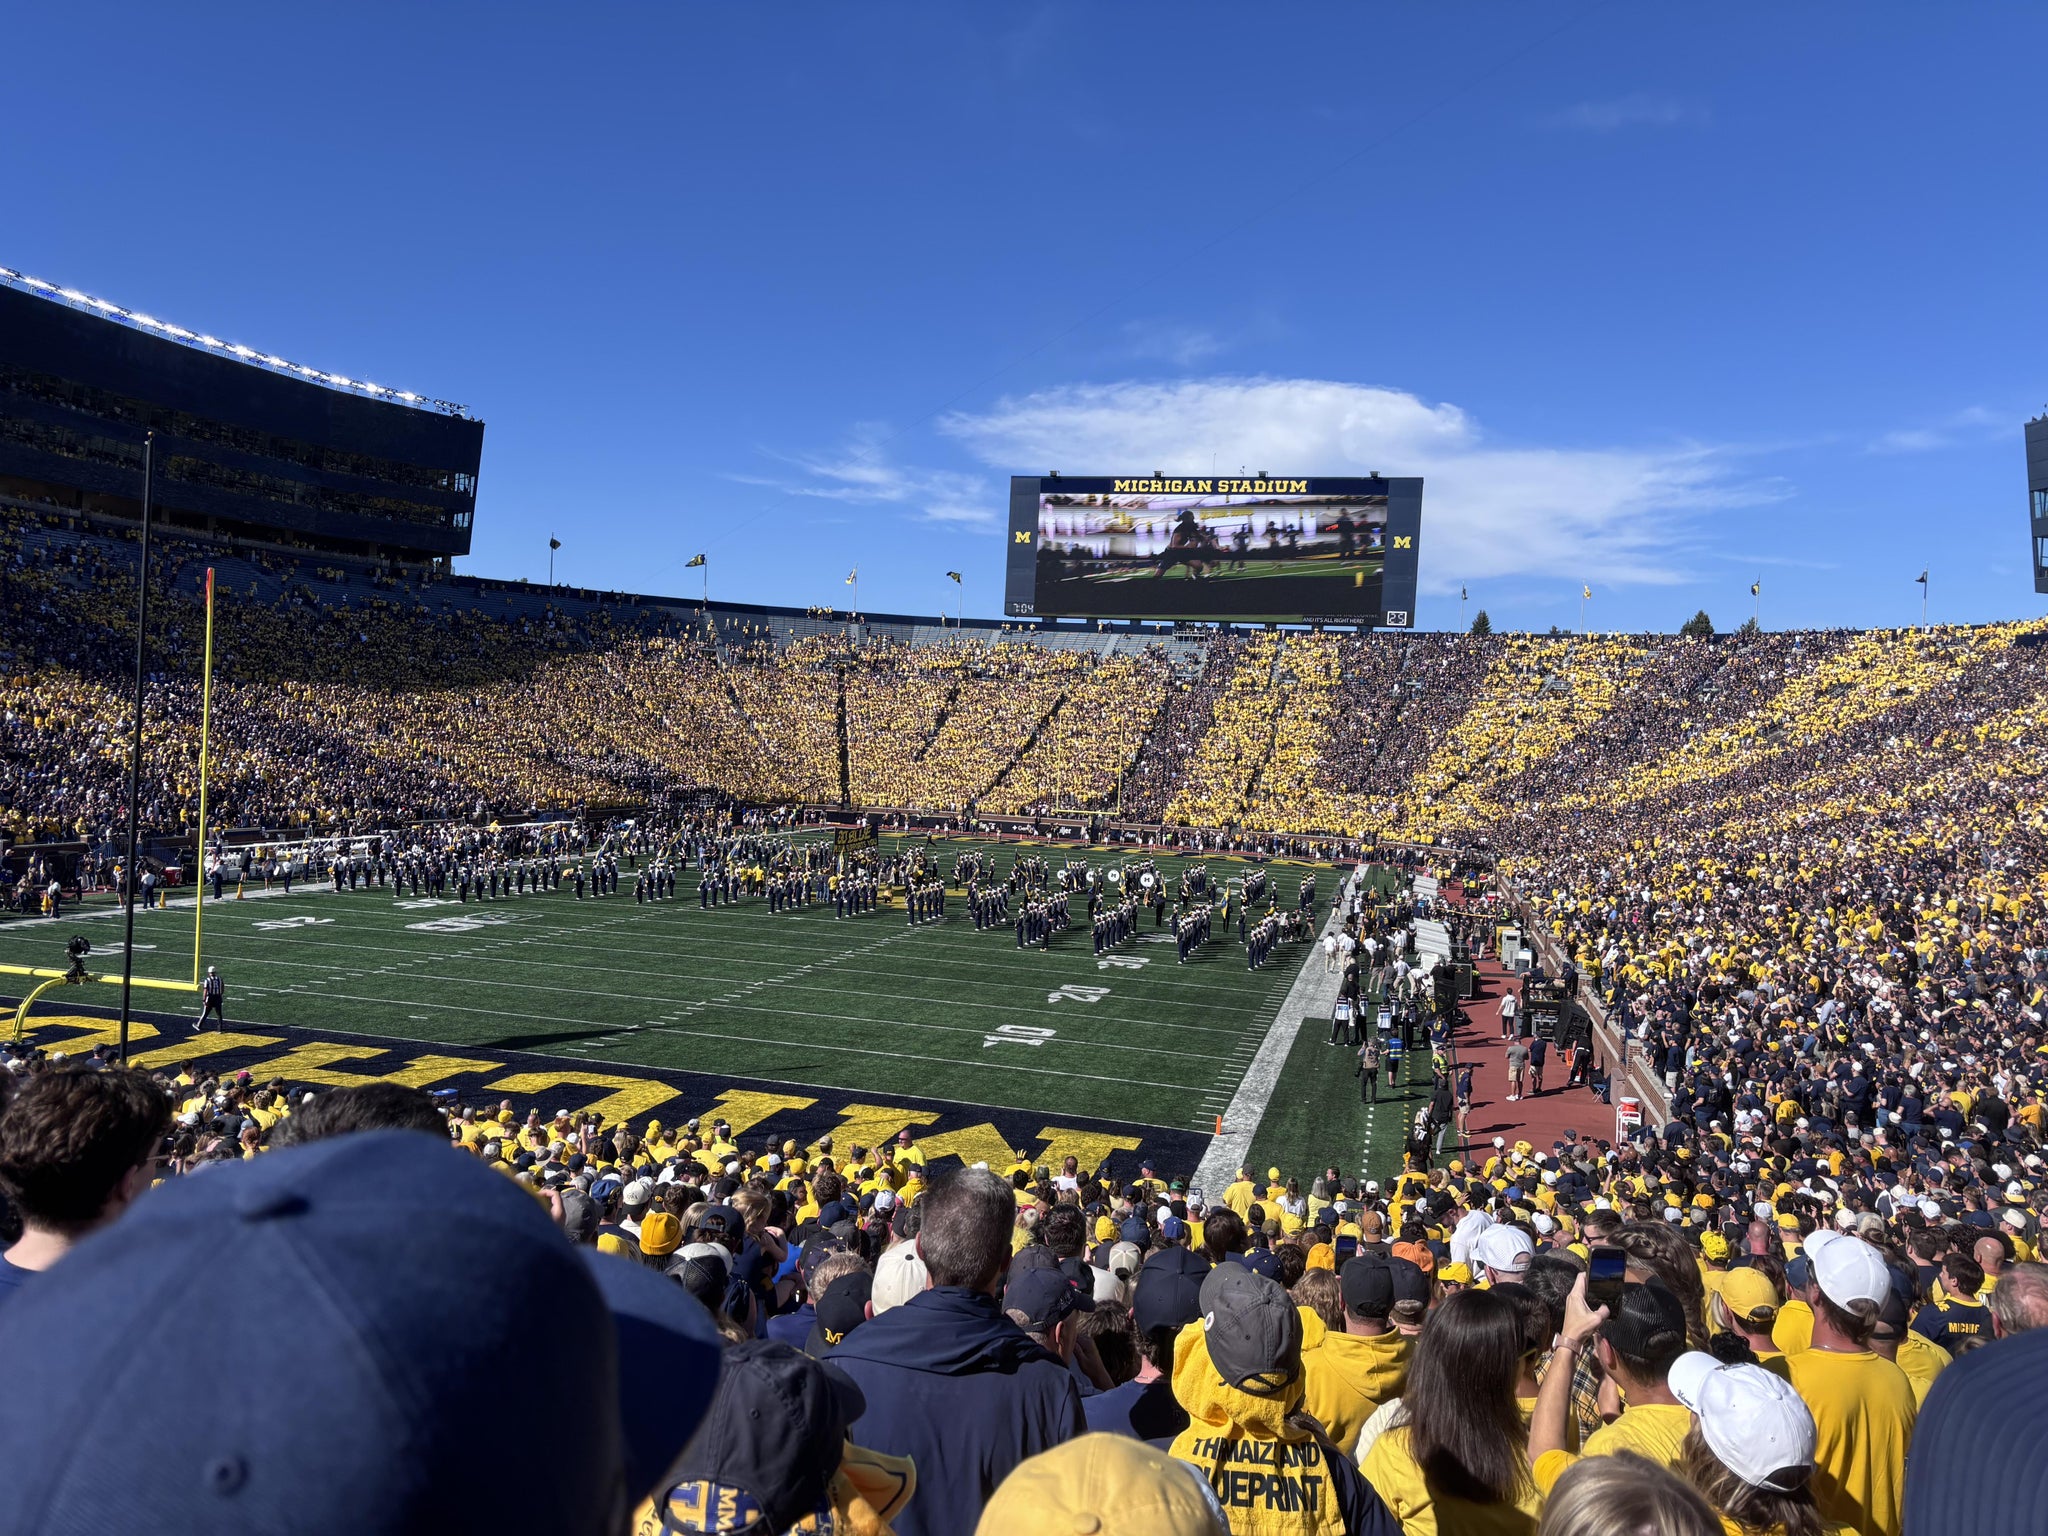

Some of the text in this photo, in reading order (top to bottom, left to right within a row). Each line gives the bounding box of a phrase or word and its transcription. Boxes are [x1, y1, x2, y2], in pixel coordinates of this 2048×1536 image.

[1114, 480, 1307, 493] MICHIGAN STADIUM
[1015, 531, 1031, 543] M
[1393, 536, 1411, 549] M
[1013, 603, 1034, 614] 7:04
[1097, 955, 1151, 969] 30
[1048, 984, 1112, 1002] 20
[984, 1024, 1057, 1046] 10
[825, 1328, 844, 1345] M
[1219, 1438, 1279, 1466] MAIZ
[1280, 1441, 1320, 1468] AND
[1196, 1464, 1323, 1512] UEPRINT
